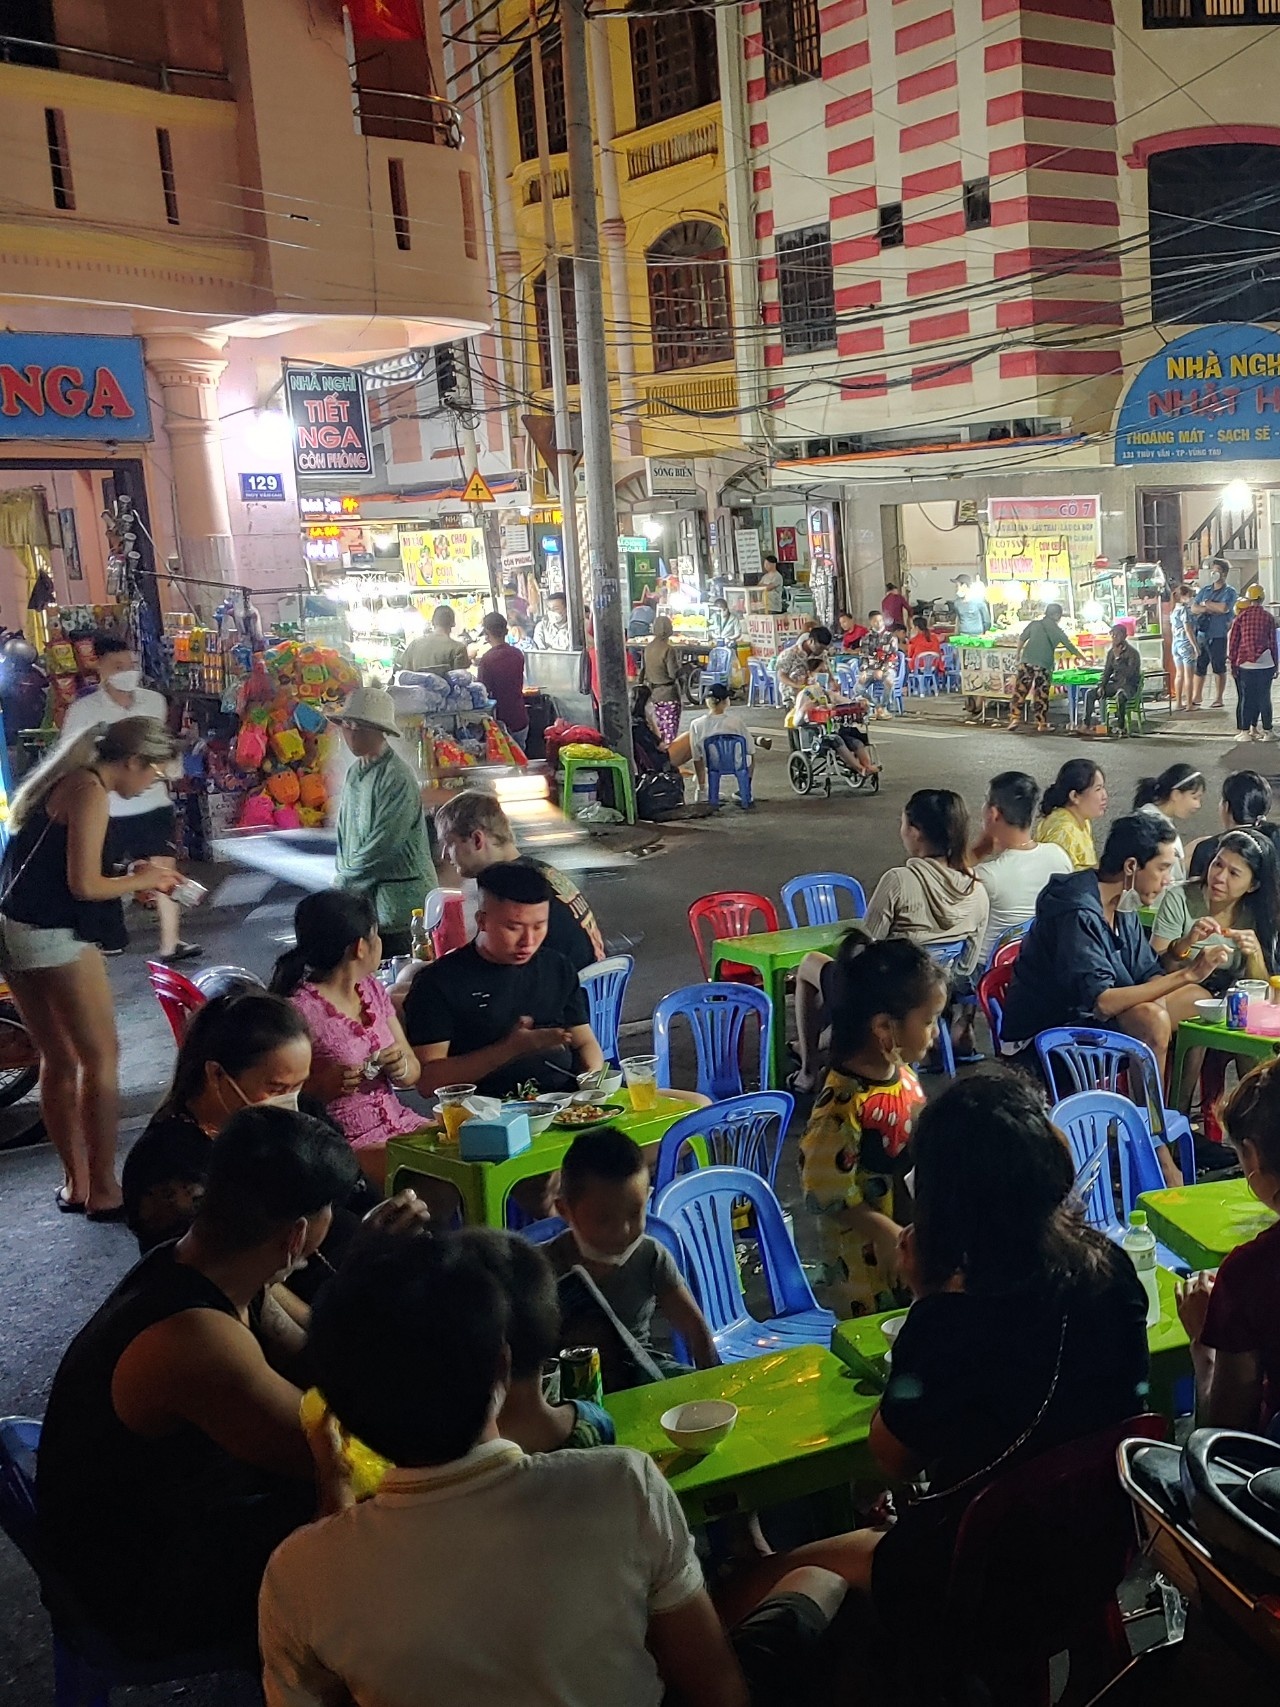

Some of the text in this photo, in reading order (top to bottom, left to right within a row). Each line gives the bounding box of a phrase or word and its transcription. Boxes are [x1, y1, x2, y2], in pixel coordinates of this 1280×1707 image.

[1167, 351, 1222, 380] NHÀ
[0, 364, 135, 418] NGA
[1148, 382, 1240, 422] NHẬT
[304, 392, 350, 423] TIẾT
[297, 425, 361, 449] NGA
[1126, 428, 1174, 445] THOÁNG
[1178, 427, 1206, 443] MÁT
[1217, 427, 1250, 444] SẠCH
[299, 448, 367, 470] CÒN PHÒNG
[653, 463, 674, 477] SÓNG
[249, 476, 278, 490] 129
[1059, 500, 1078, 516] CÔ
[1082, 503, 1092, 516] 7
